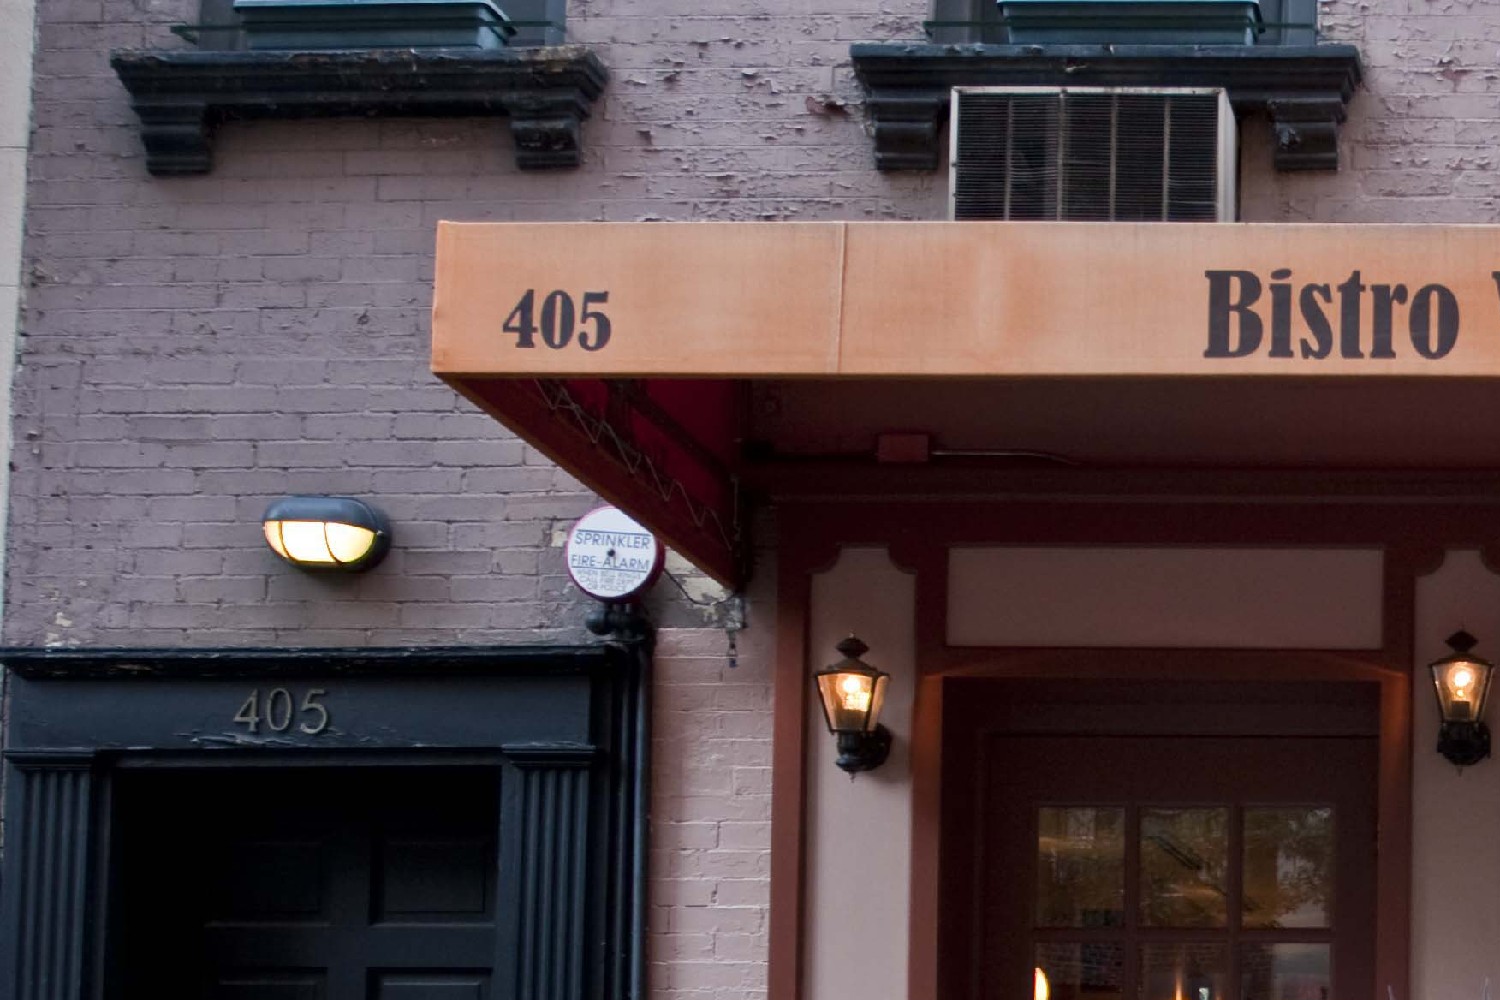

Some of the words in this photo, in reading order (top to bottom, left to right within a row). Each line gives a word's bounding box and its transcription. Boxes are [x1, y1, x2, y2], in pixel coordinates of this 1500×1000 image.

[502, 288, 612, 352] 405
[1202, 268, 1460, 361] Bistro
[570, 554, 650, 569] FIRE-ALARM
[574, 532, 650, 549] SPRINKLER
[232, 687, 329, 735] 405
